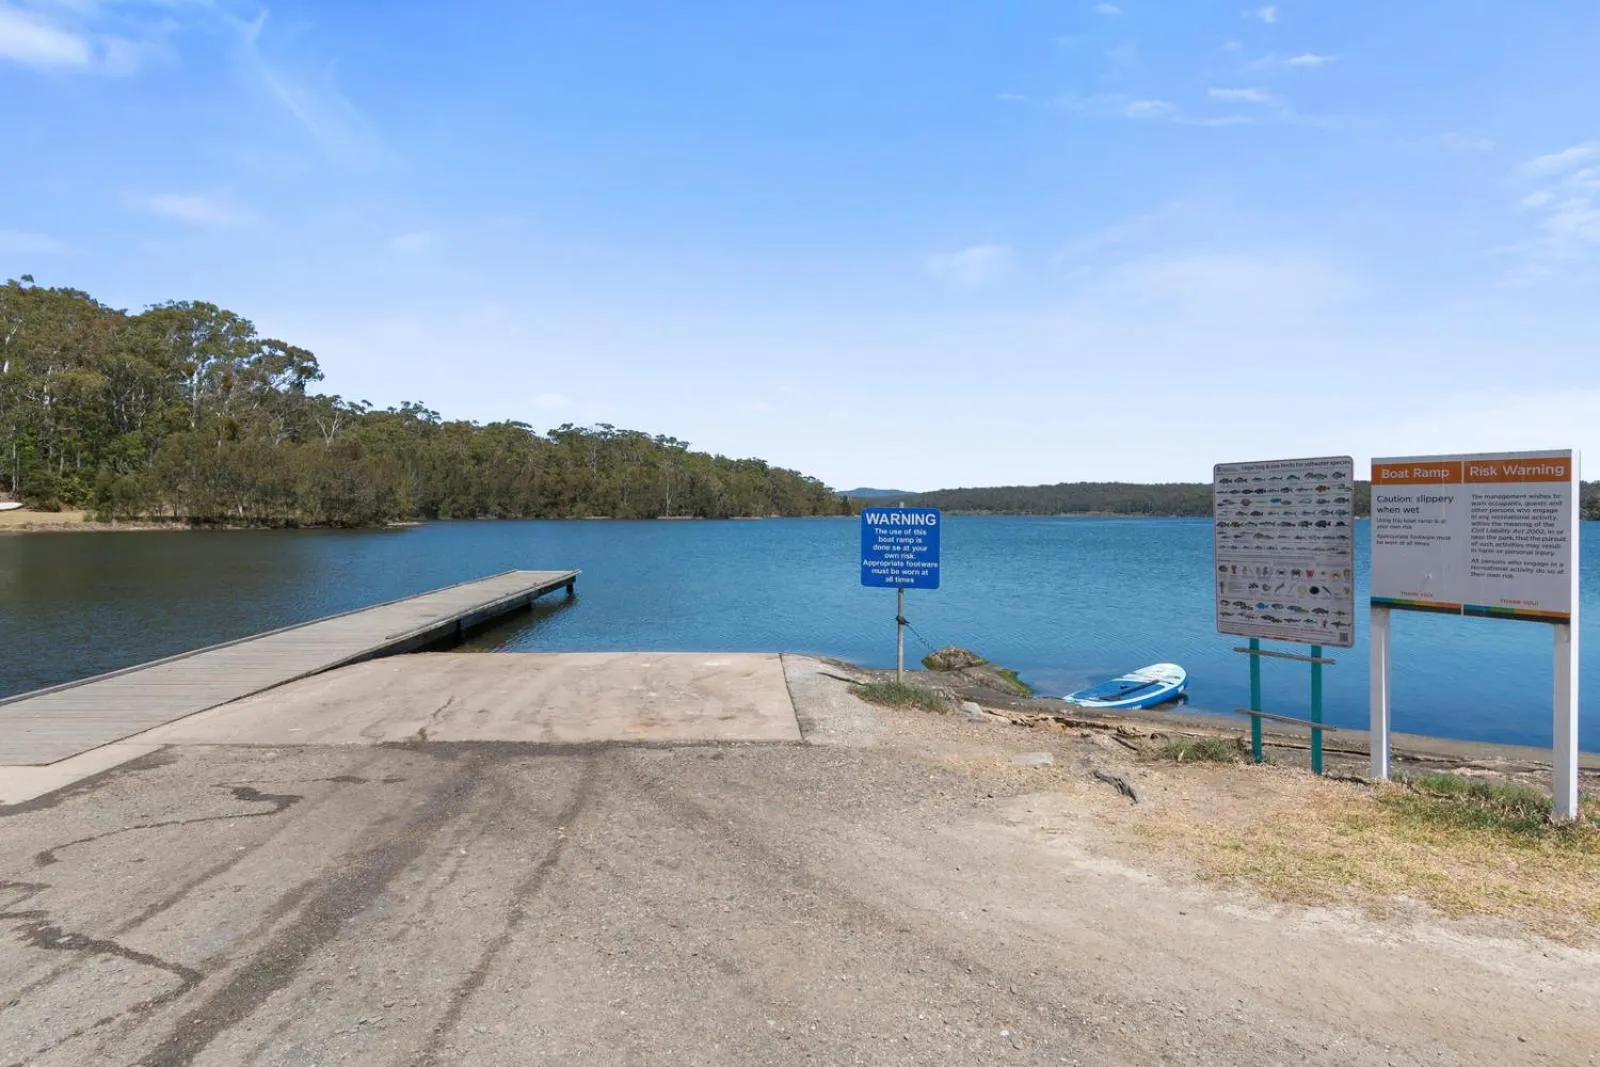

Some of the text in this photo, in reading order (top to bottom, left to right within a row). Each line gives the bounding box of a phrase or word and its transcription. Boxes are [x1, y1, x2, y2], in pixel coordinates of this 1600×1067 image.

[1382, 468, 1449, 478] Boat Ramp
[1470, 464, 1564, 476] Risk Warning
[1416, 495, 1454, 504] slippery
[866, 513, 936, 525] WARNING
